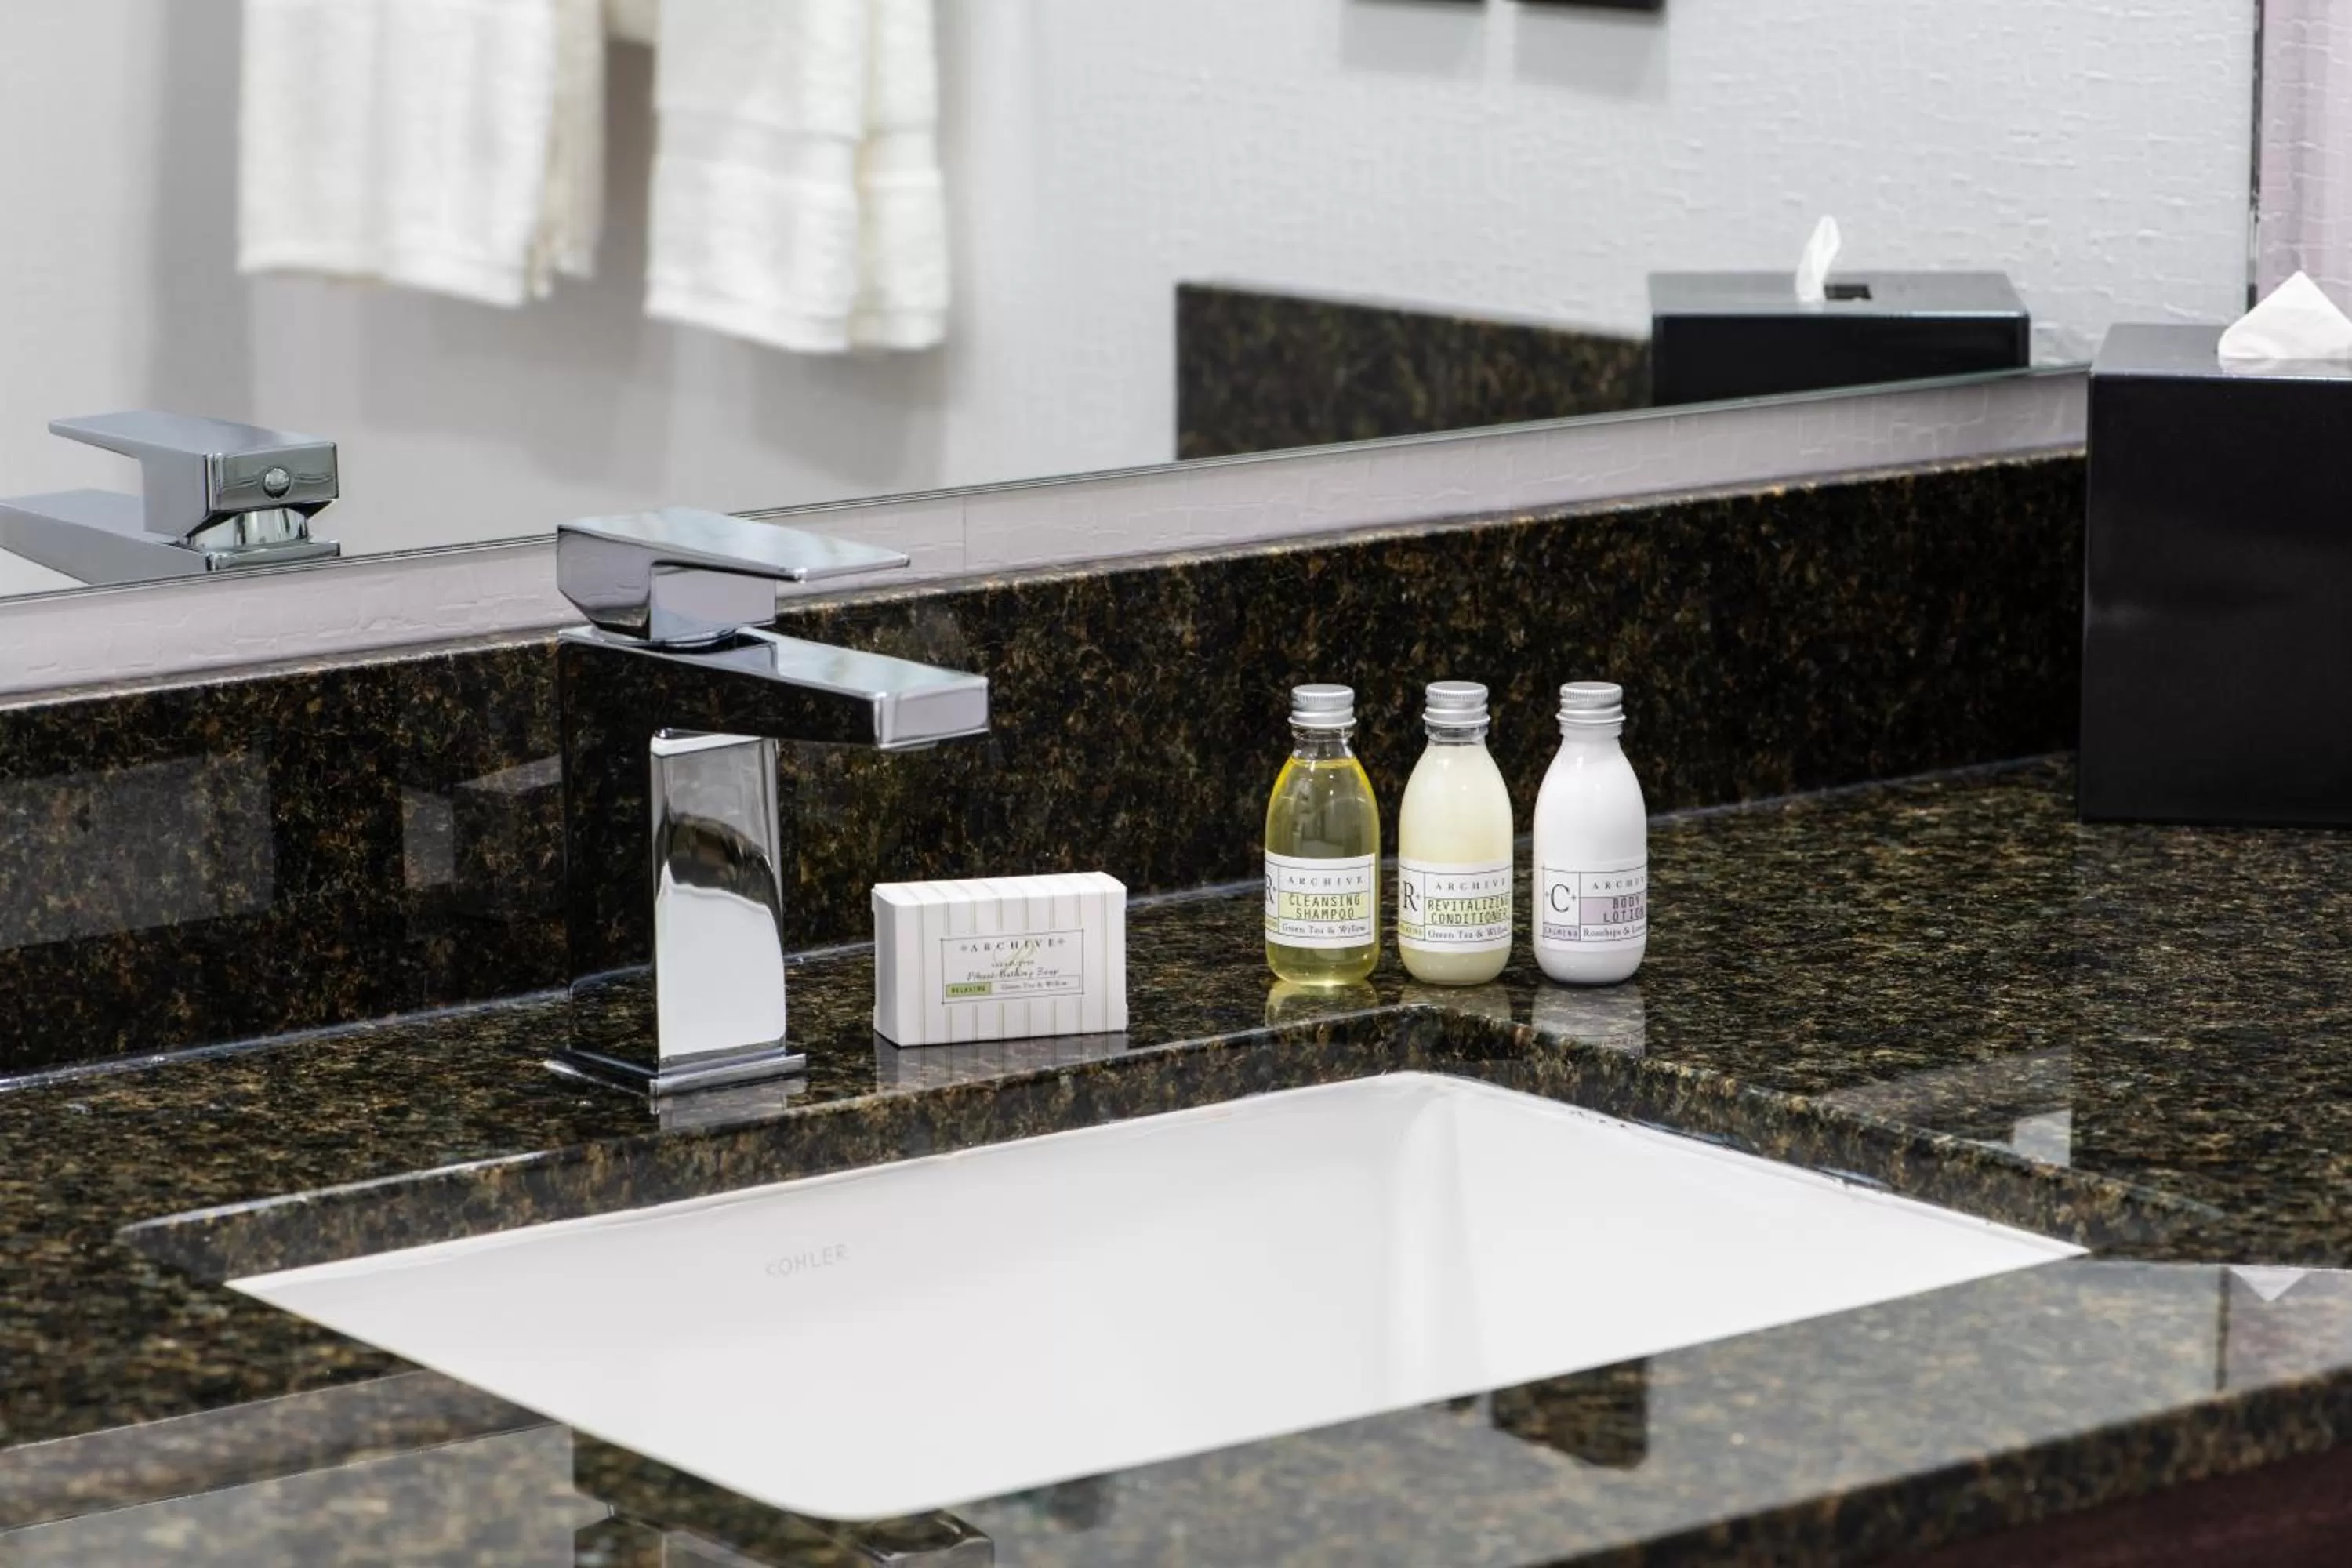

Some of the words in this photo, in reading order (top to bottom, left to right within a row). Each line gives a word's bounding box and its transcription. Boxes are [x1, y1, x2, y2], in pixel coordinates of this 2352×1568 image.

[1288, 876, 1363, 887] ARCHIVE
[1592, 876, 1646, 890] ARCHIV
[1288, 895, 1361, 907] CLEANSING
[1403, 880, 1418, 912] R
[1550, 883, 1570, 913] C
[1612, 896, 1640, 910] BODY
[1296, 908, 1355, 920] SHAMPOO
[1282, 923, 1305, 934] Green
[1308, 924, 1324, 935] Tea
[1428, 929, 1454, 939] Green
[1459, 929, 1474, 938] Tea
[970, 938, 1056, 953] ARCHIVE
